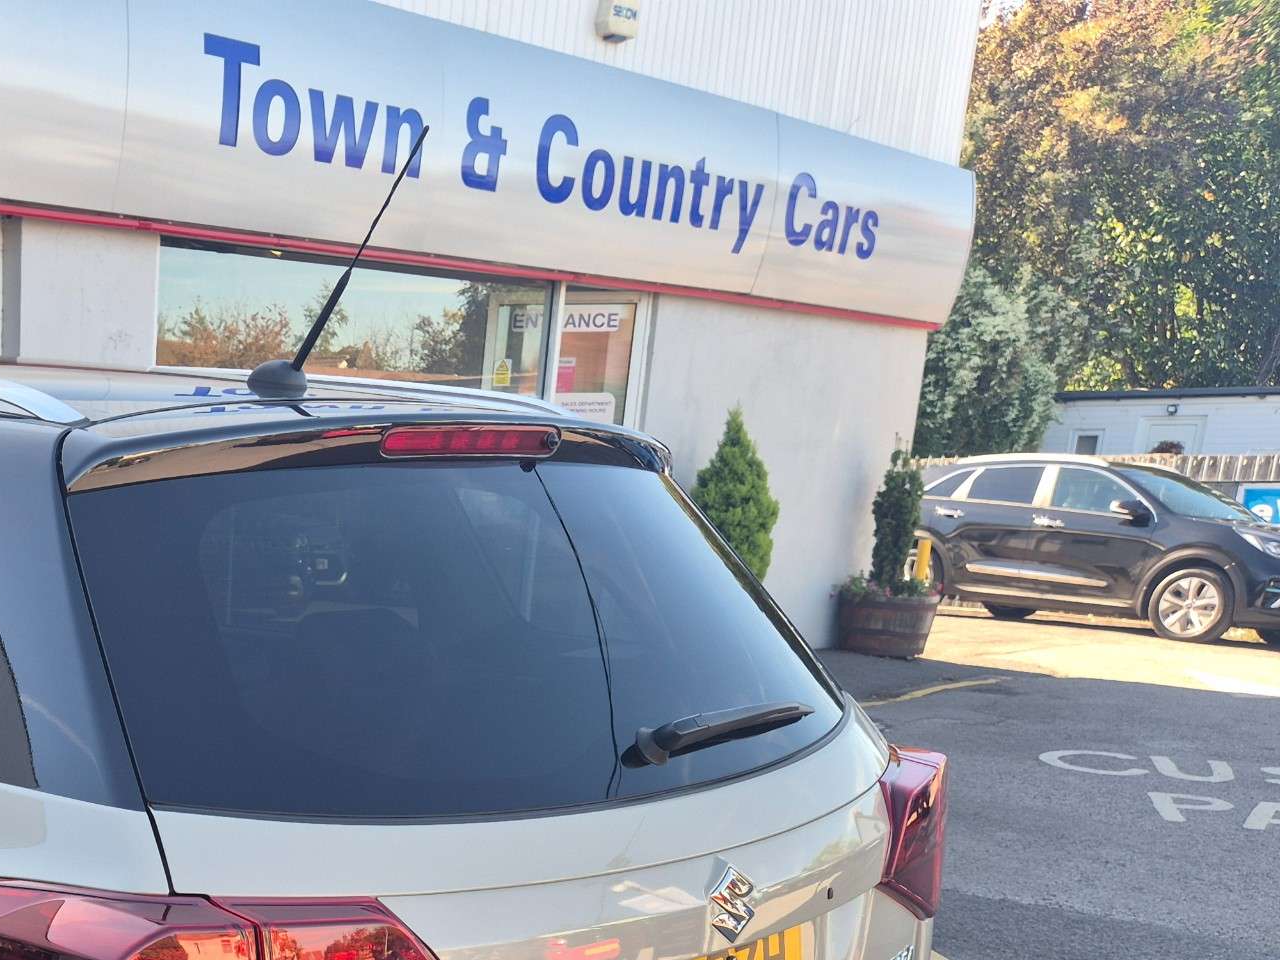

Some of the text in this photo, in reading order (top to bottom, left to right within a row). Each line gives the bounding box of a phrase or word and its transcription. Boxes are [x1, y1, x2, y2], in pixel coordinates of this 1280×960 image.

[204, 32, 879, 260] Town & Country Cars
[512, 312, 619, 329] ENANCE
